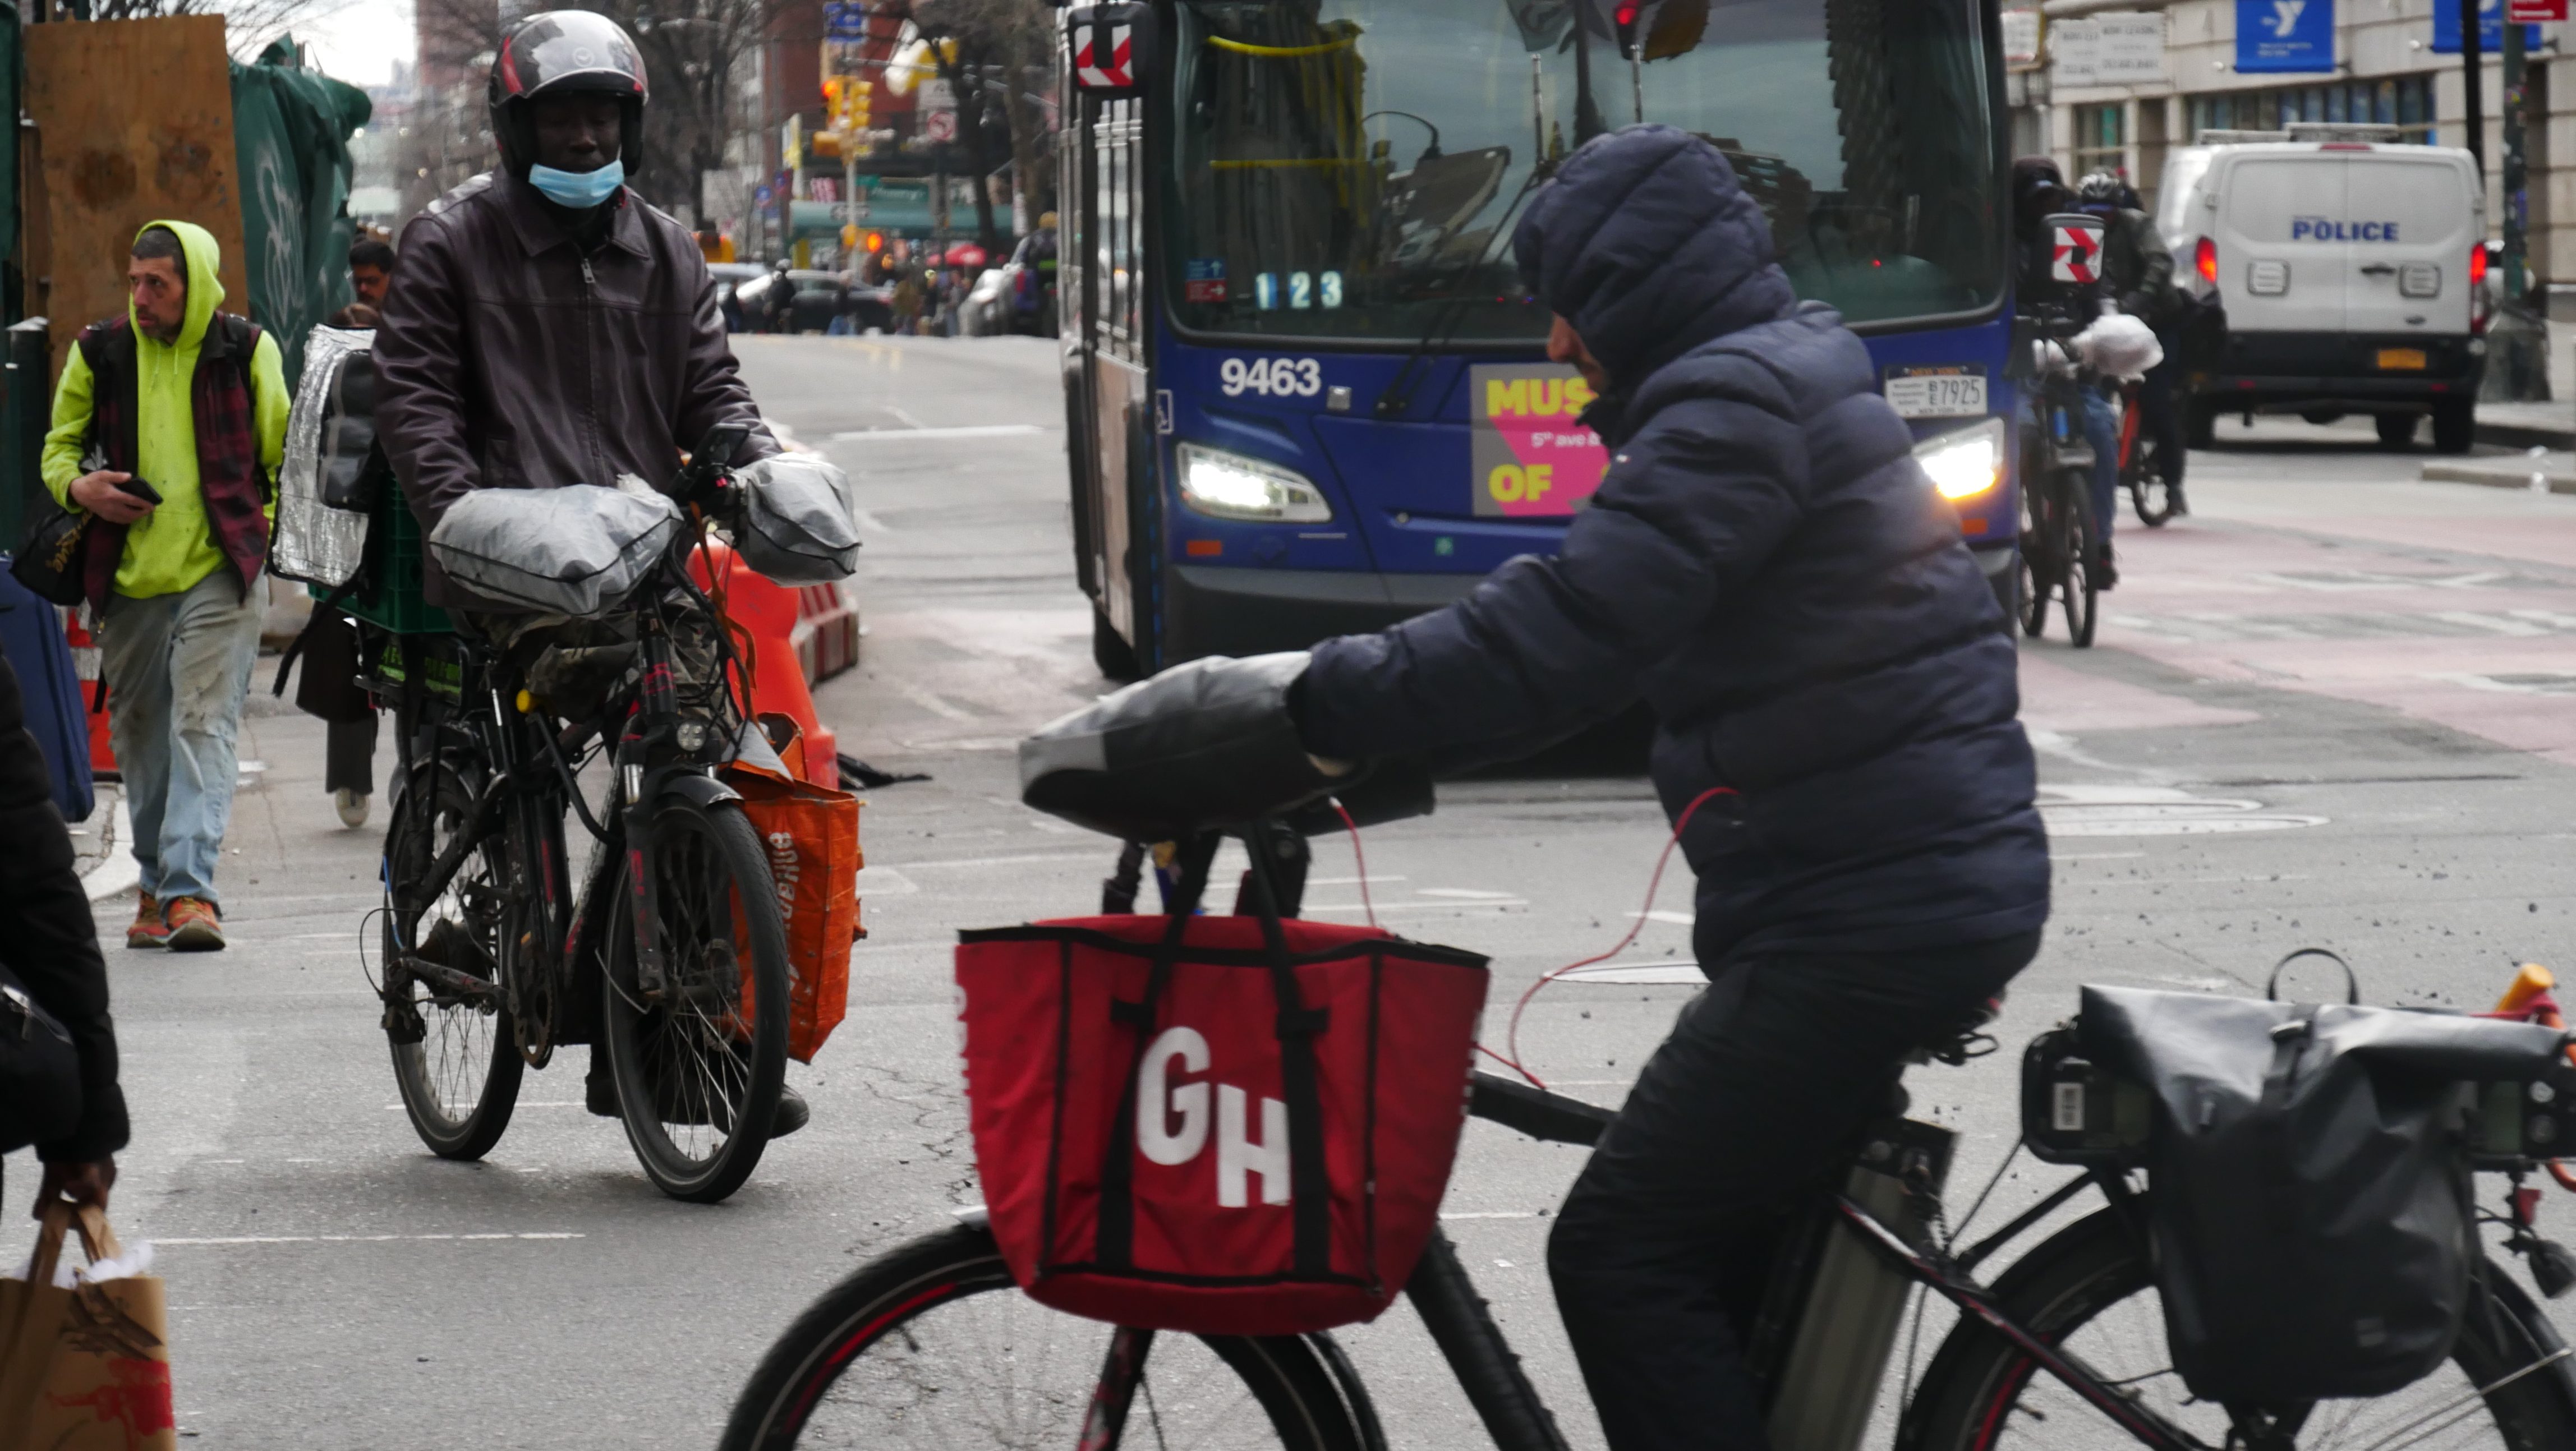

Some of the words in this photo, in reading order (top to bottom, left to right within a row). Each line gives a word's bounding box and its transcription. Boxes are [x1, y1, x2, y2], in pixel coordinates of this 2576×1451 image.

[2293, 220, 2399, 241] POLICE
[1256, 272, 1269, 310] 1
[1290, 270, 1311, 308] 2
[1320, 270, 1342, 307] 3
[1220, 357, 1322, 397] 9463
[1940, 379, 1980, 405] 7925
[1488, 463, 1553, 503] OF
[1136, 1026, 1291, 1208] GH
